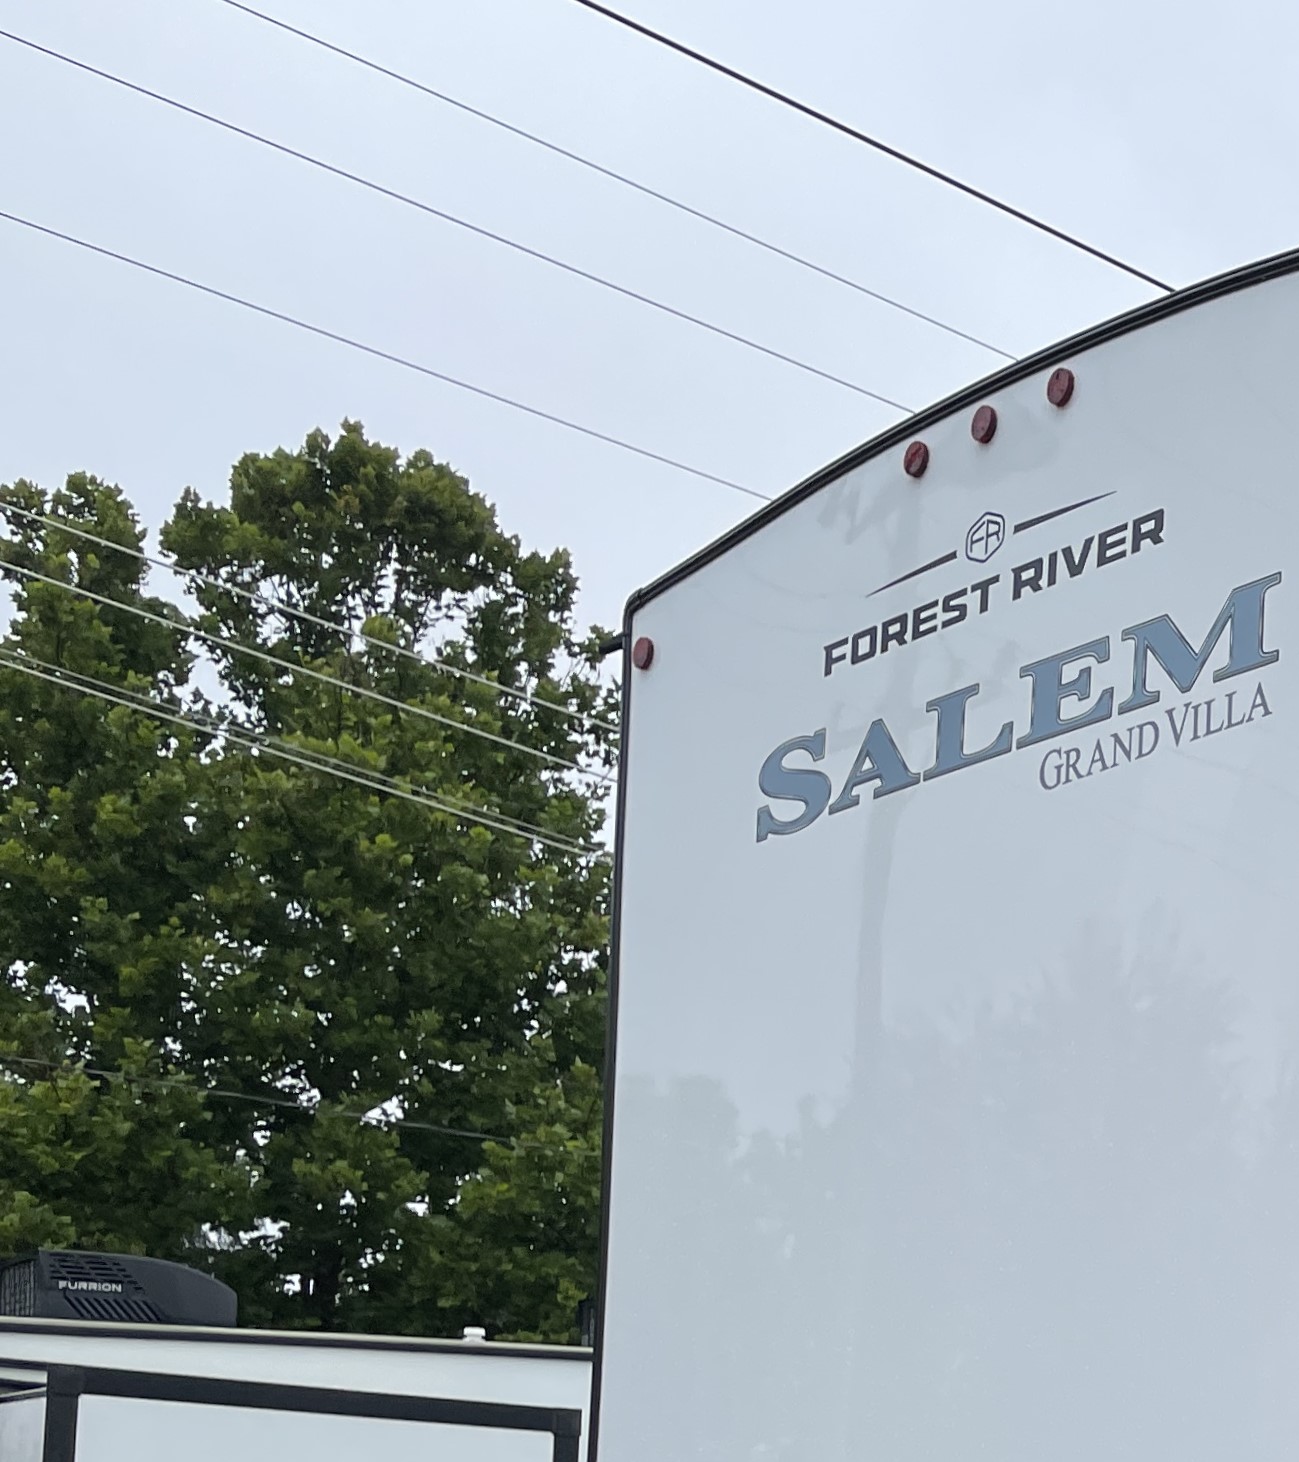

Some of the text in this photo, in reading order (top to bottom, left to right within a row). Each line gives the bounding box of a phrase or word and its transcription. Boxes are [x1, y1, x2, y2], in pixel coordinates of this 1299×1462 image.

[824, 508, 1165, 677] FOREST RIVER
[755, 571, 1282, 842] SALEM
[1038, 681, 1273, 790] GRAND VILLA
[58, 1280, 122, 1292] FURRION
